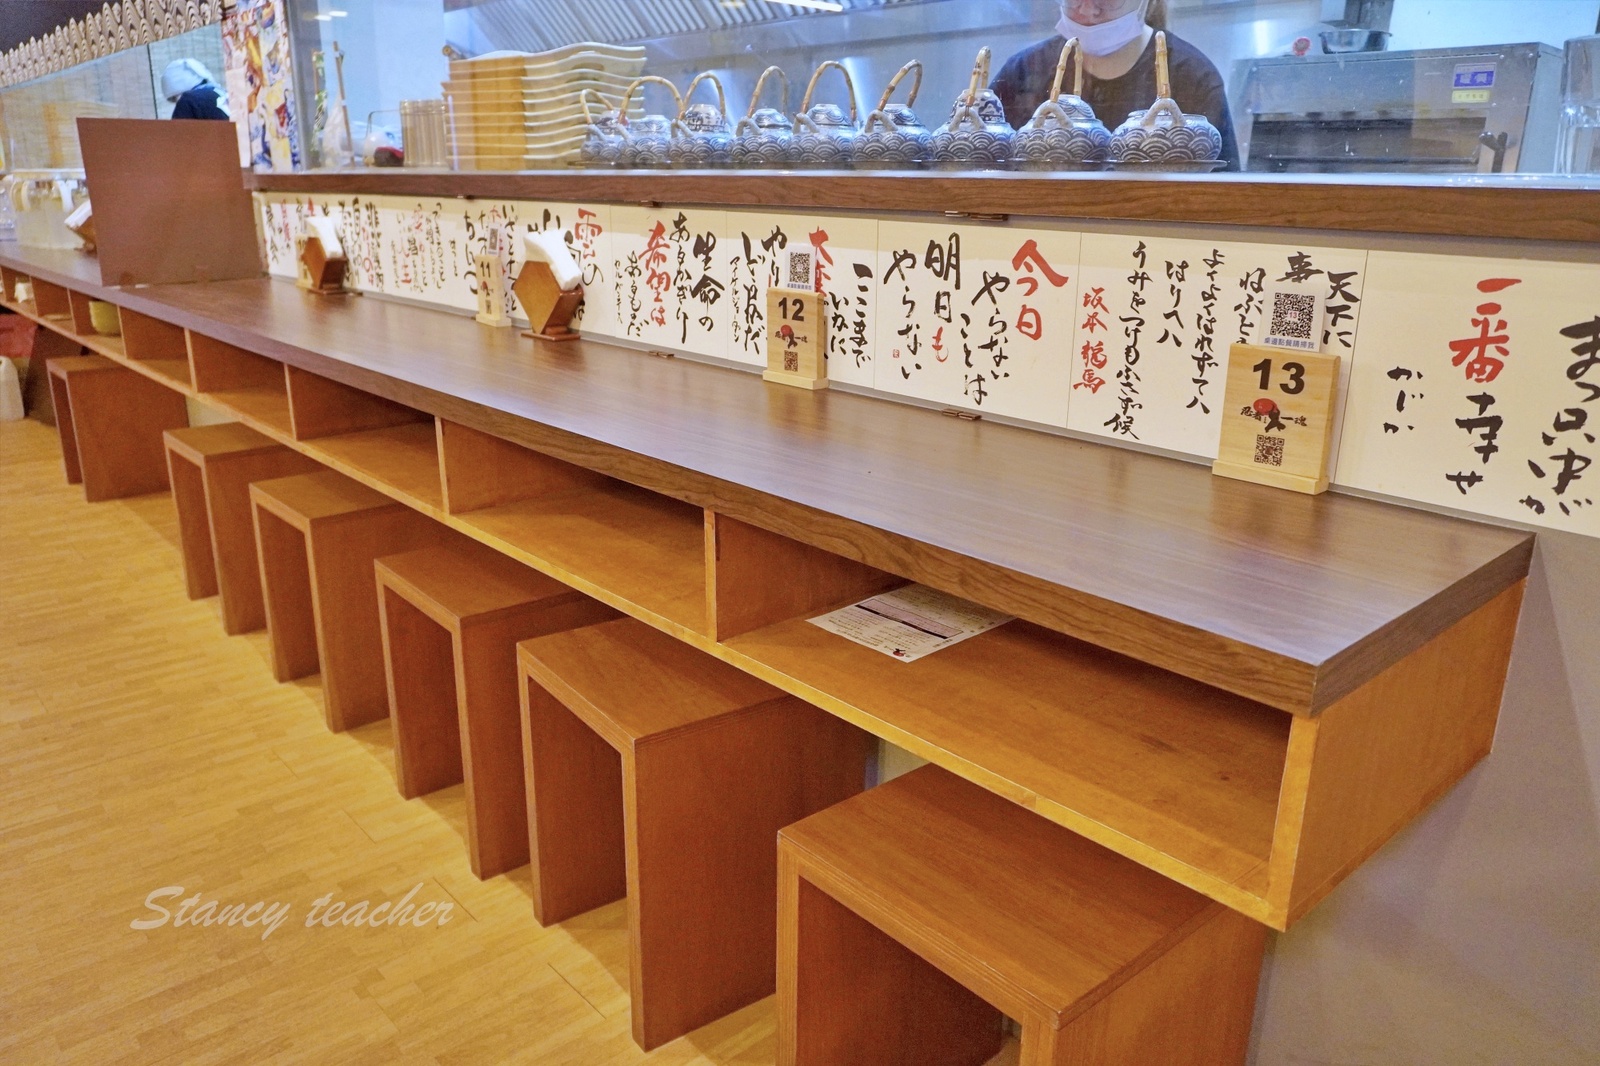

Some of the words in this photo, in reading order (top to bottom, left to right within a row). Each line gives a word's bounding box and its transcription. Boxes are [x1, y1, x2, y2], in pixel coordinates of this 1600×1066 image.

[480, 261, 492, 278] 11
[1012, 239, 1069, 341] 今日
[778, 297, 805, 322] 12
[829, 292, 849, 355] いかに
[883, 249, 922, 379] やらない
[971, 271, 1010, 380] やらない
[1323, 271, 1360, 347] 天下に
[960, 313, 988, 405] ことは
[1253, 358, 1306, 395] 13
[1446, 278, 1522, 494] 一番幸せ
[1383, 366, 1425, 434] かじか
